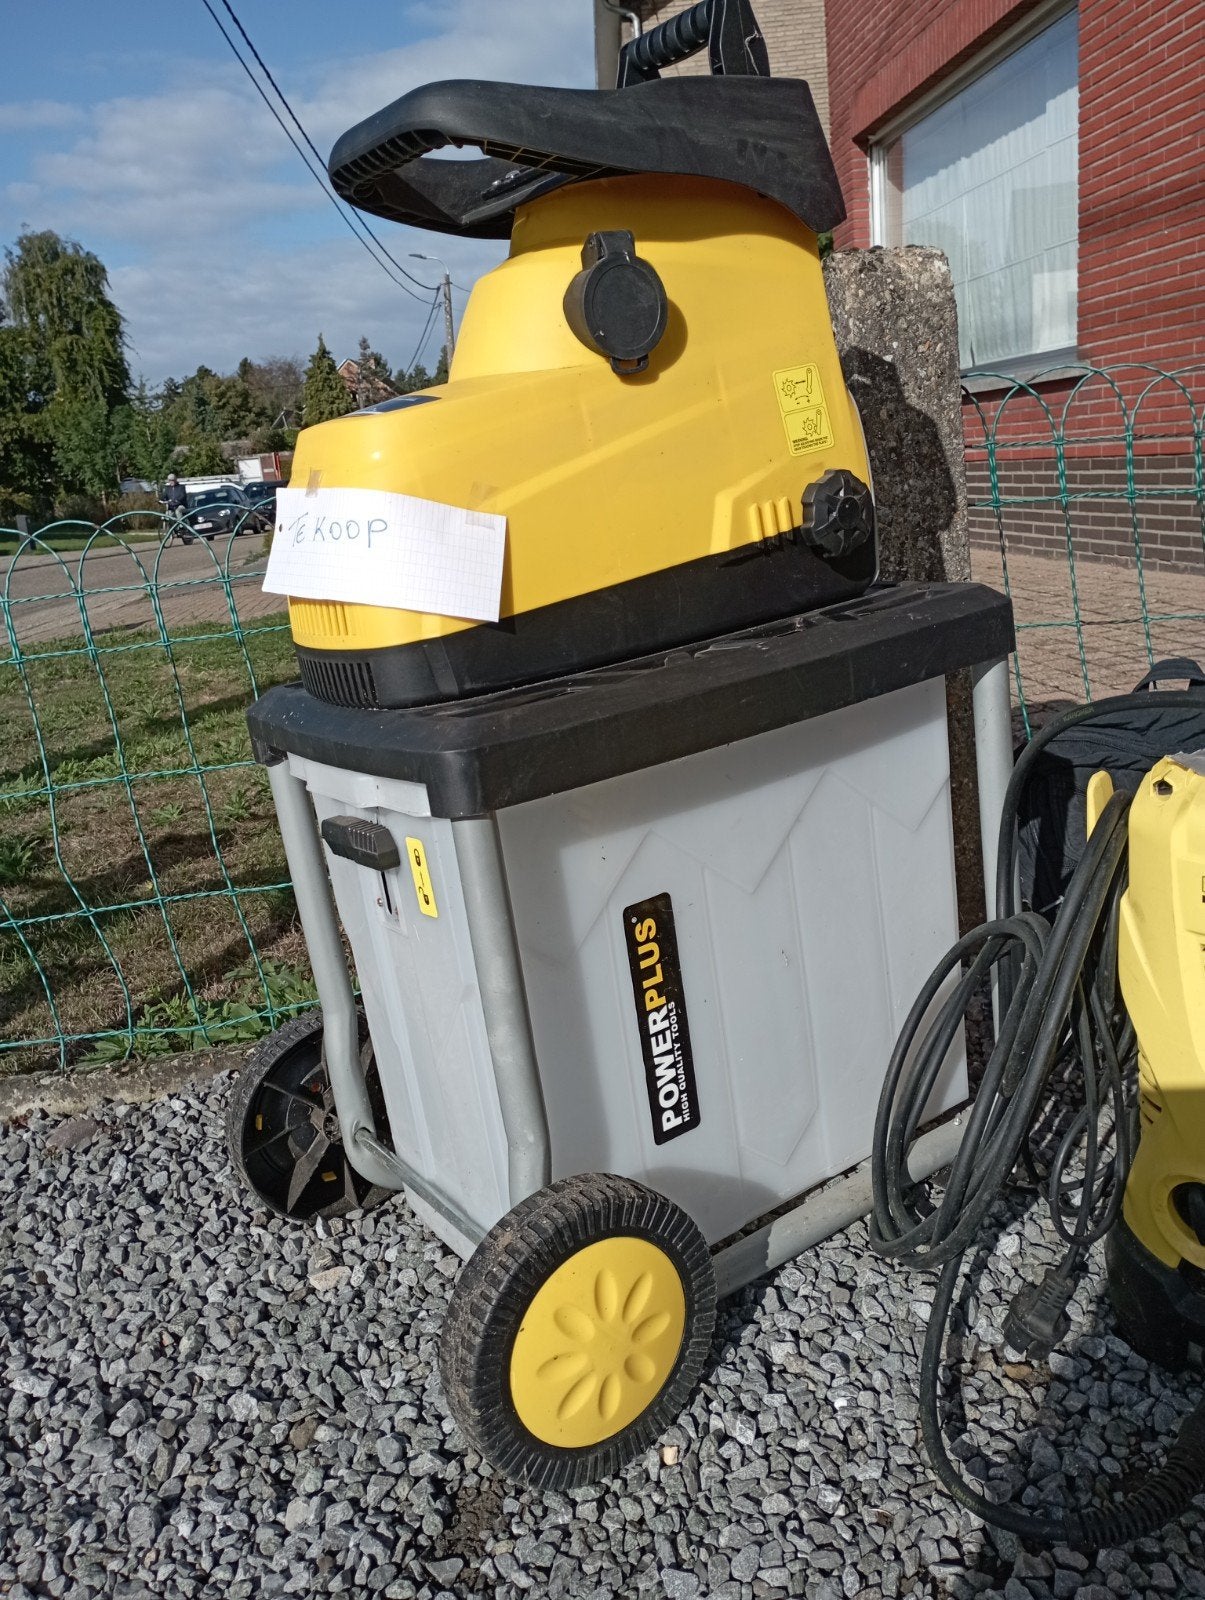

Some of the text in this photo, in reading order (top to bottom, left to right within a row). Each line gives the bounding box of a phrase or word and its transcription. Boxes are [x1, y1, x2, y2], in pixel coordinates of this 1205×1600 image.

[313, 516, 388, 548] KOOP
[635, 918, 683, 1132] POWERPLUS
[668, 1001, 691, 1122] HIGH QUALITY TOOLS
